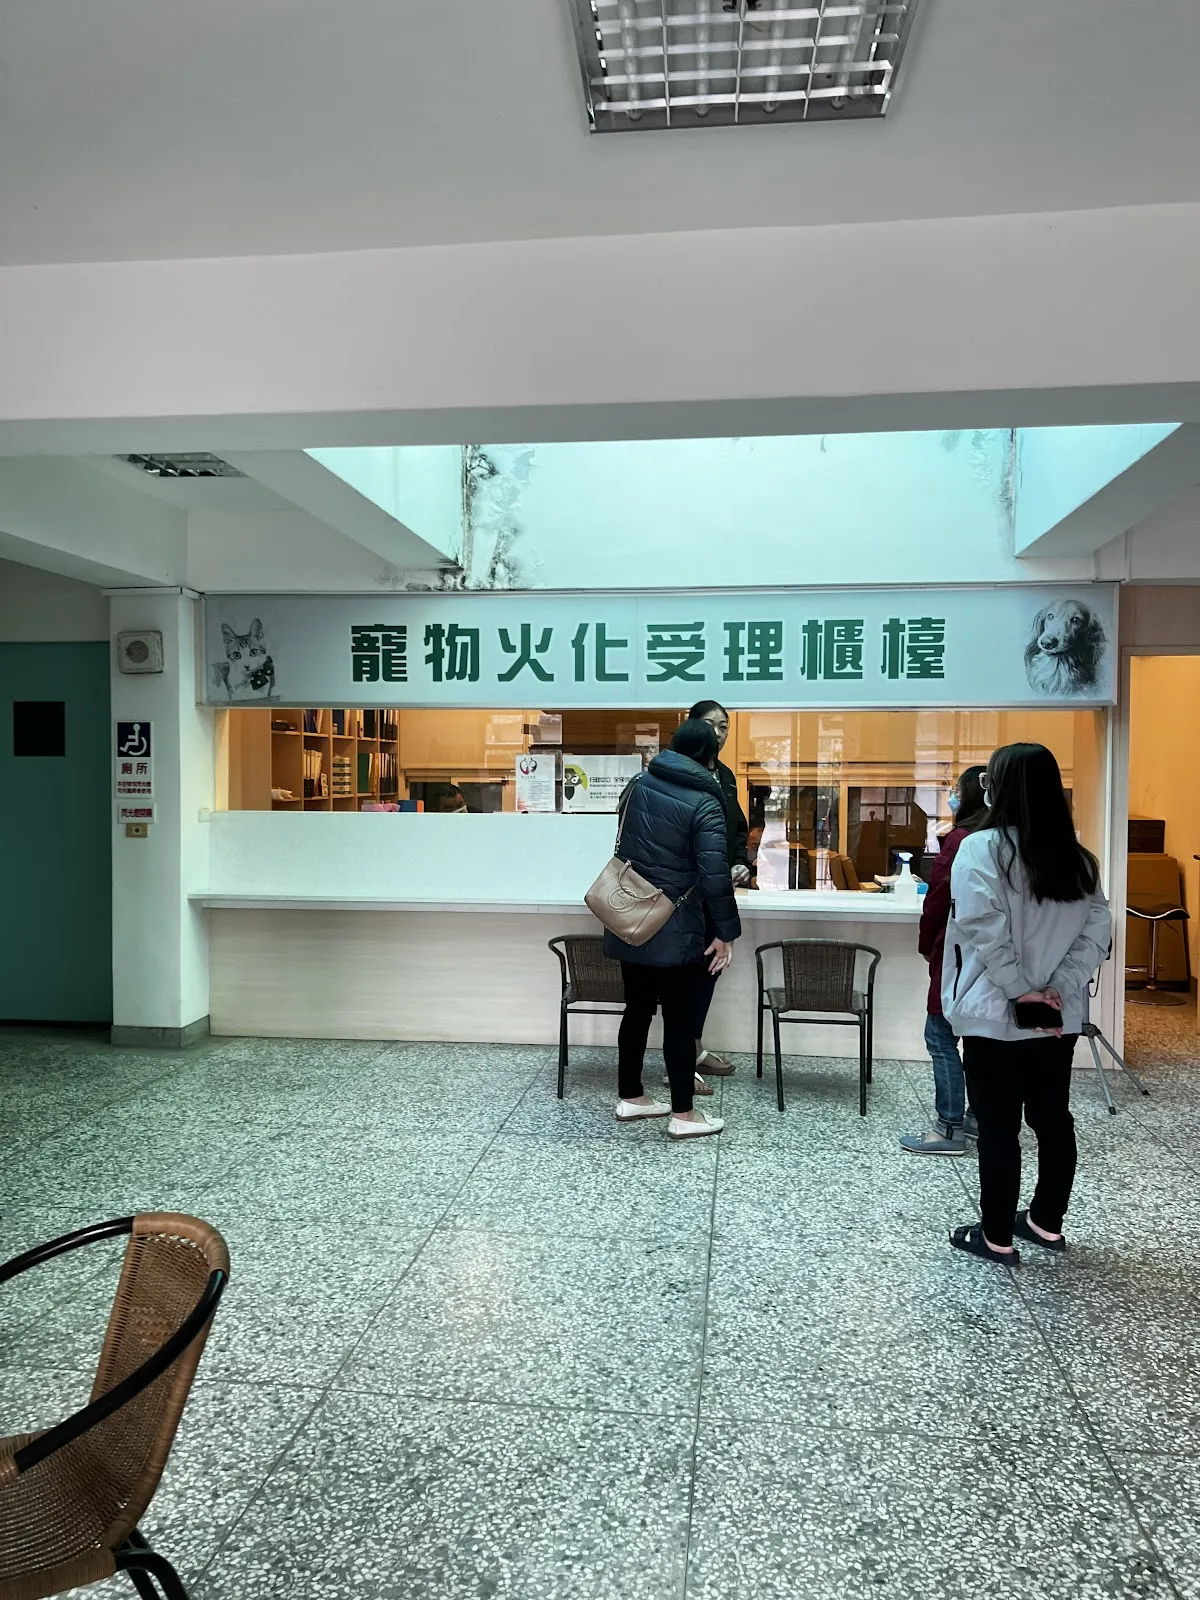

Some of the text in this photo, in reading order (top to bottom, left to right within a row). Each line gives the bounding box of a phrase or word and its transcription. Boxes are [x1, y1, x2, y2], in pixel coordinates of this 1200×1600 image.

[350, 617, 946, 683] 寵物火化受理櫃檯
[121, 762, 148, 775] 廁所
